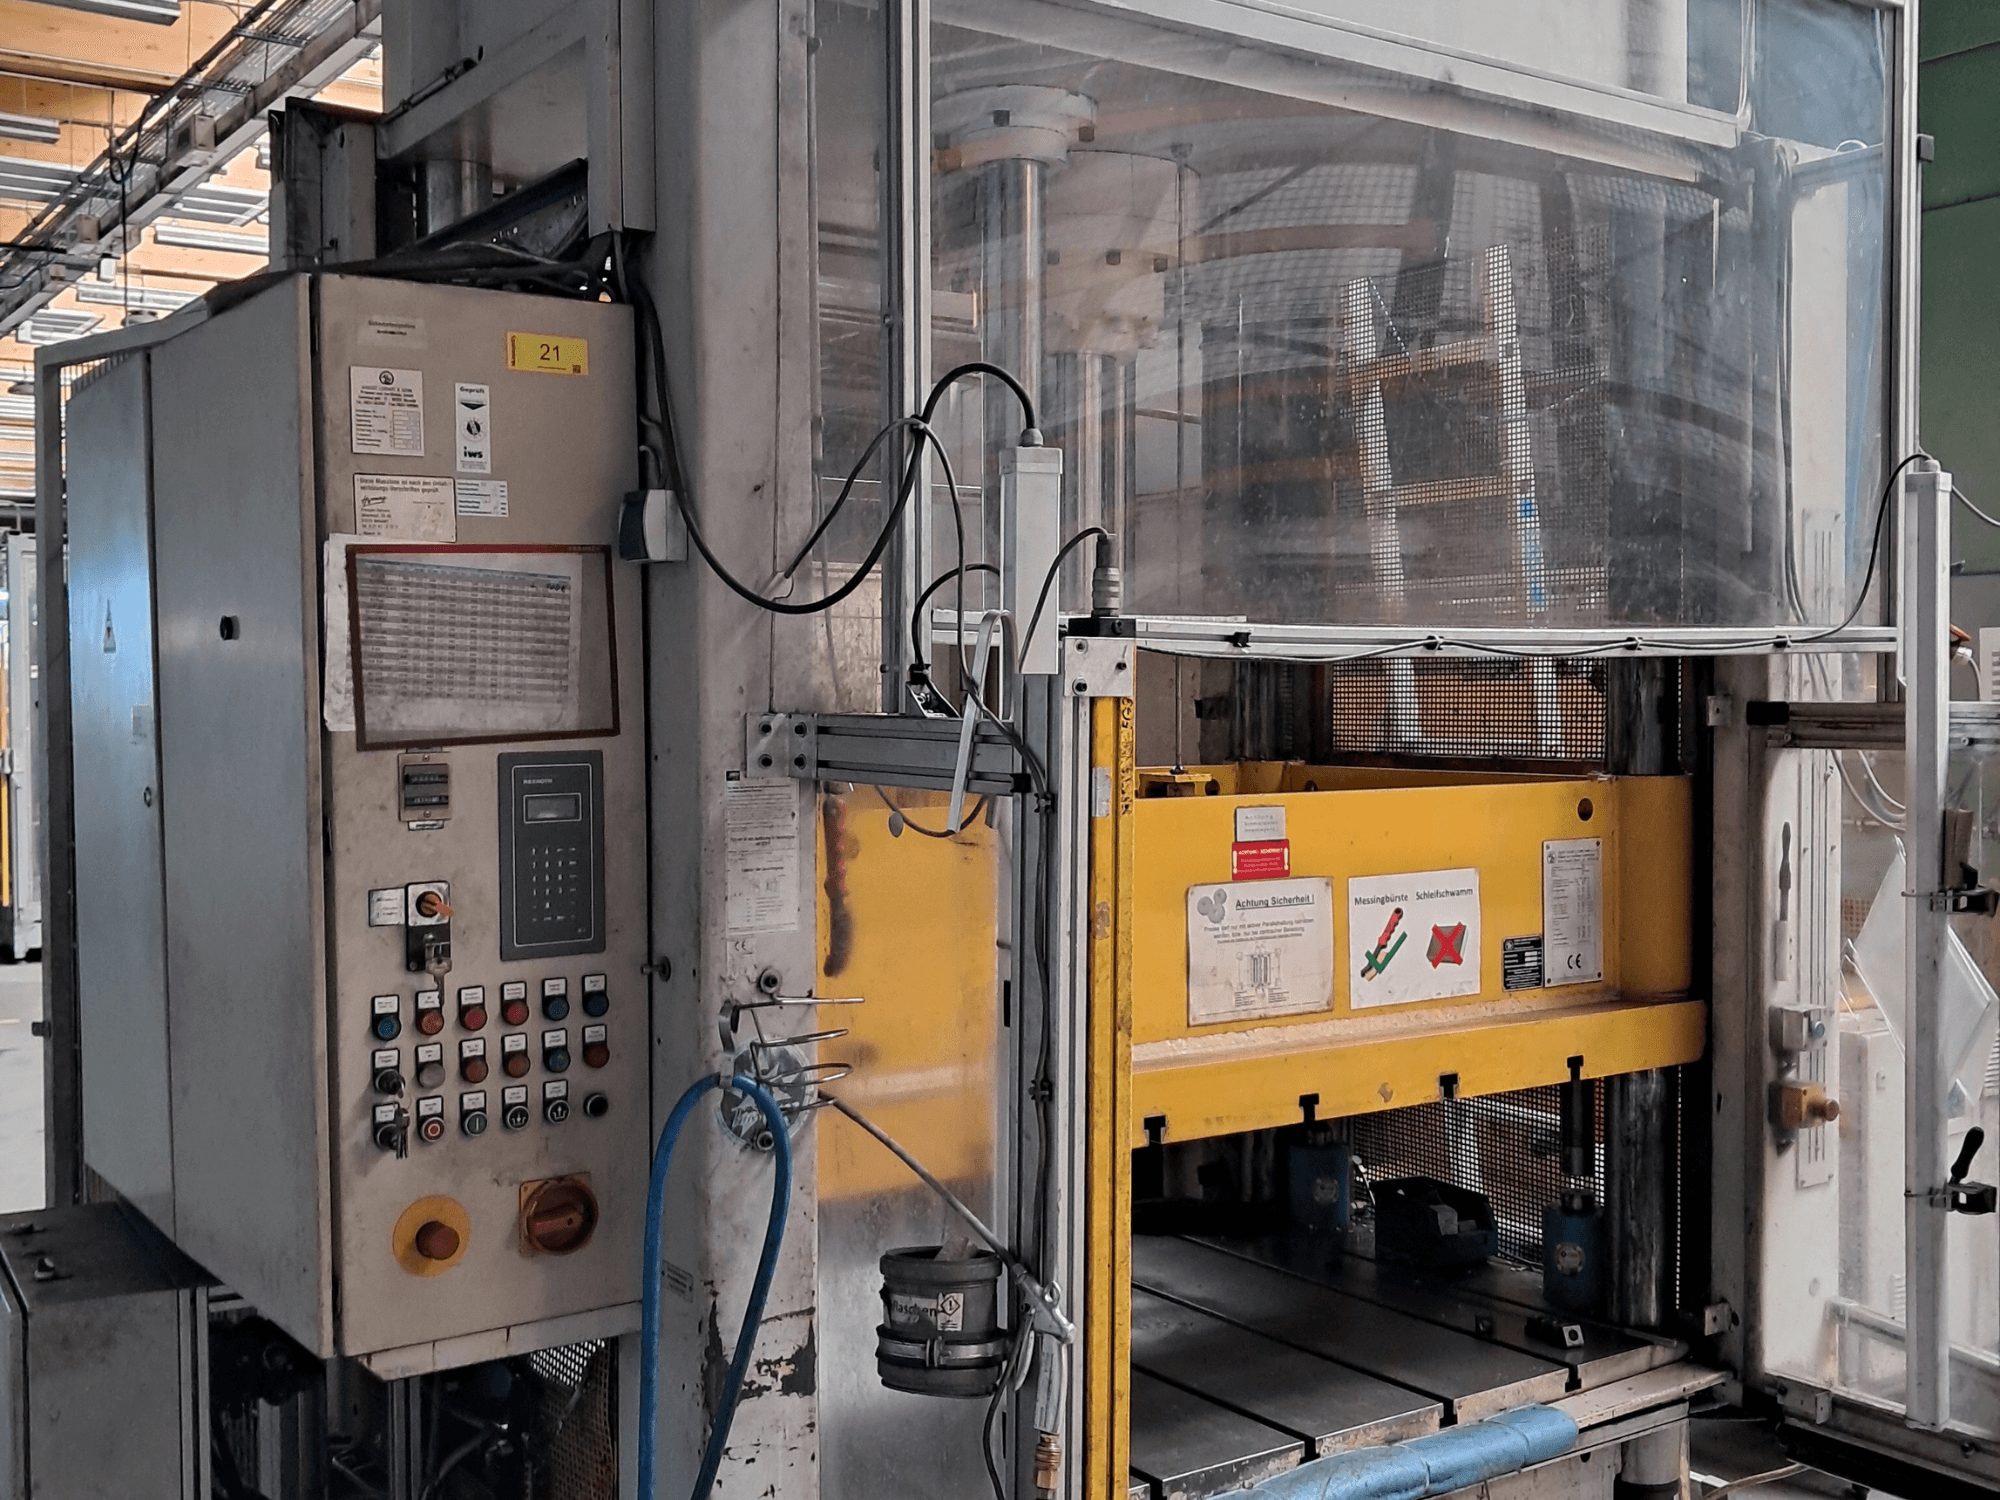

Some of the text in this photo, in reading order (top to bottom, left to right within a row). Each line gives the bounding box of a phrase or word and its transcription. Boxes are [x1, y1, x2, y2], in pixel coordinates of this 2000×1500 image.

[540, 343, 560, 361] 21
[463, 445, 483, 459] iws
[1236, 898, 1269, 908] Achtung
[1271, 894, 1310, 905] Sicherheit
[1354, 888, 1474, 905] Messingbürste Schleifschwamm
